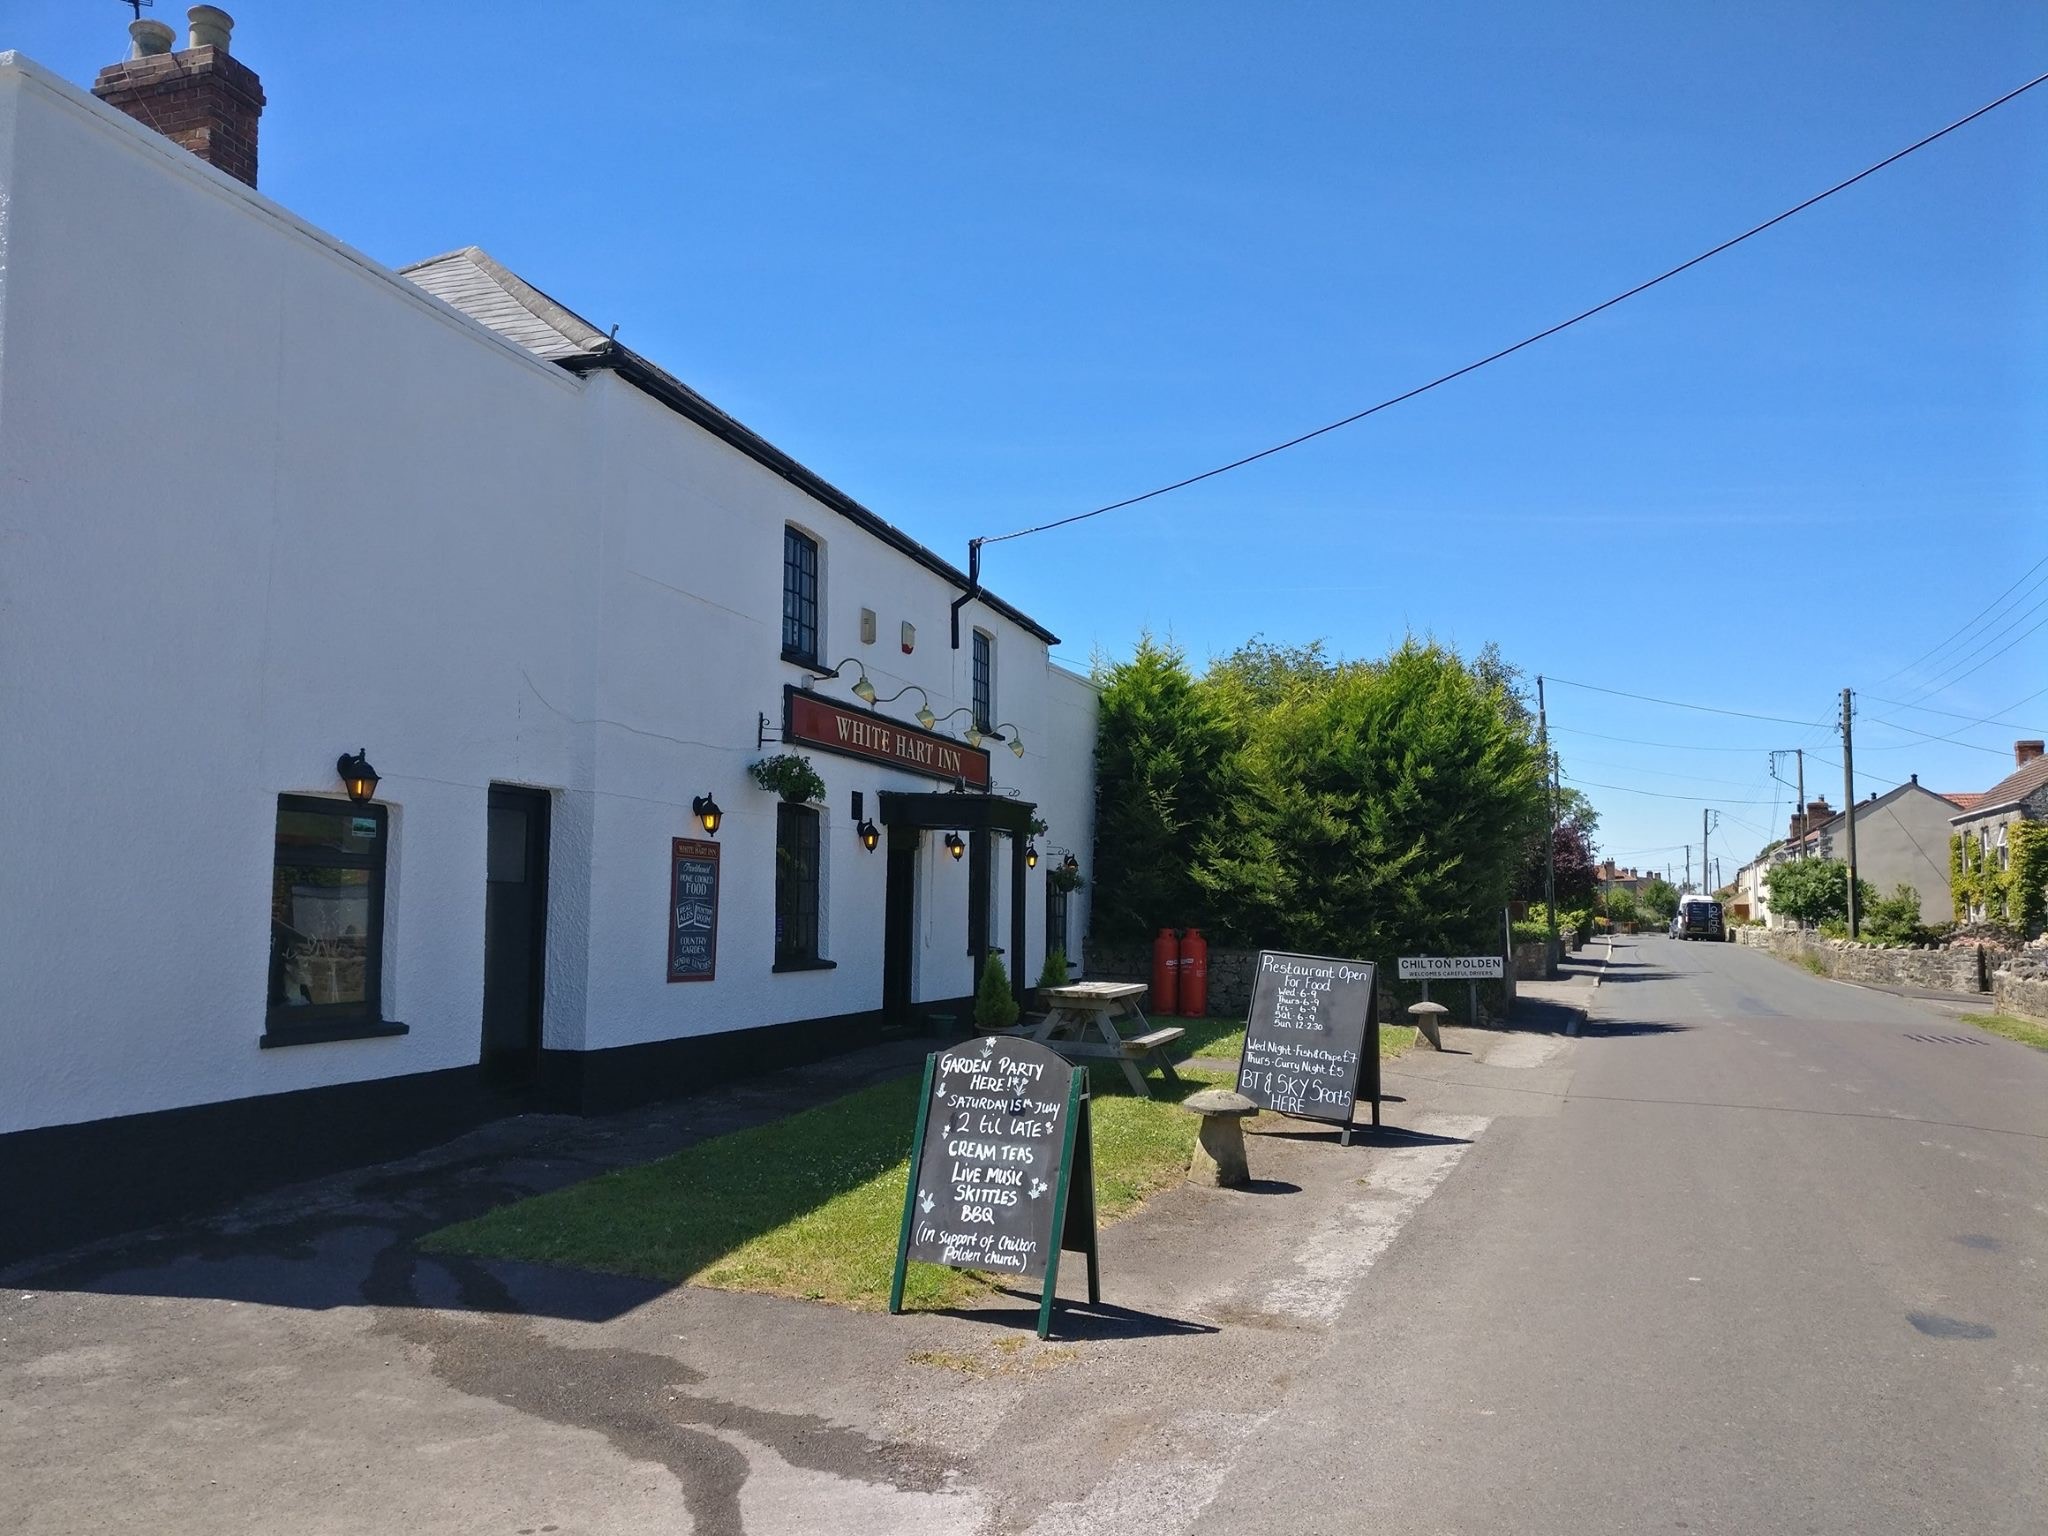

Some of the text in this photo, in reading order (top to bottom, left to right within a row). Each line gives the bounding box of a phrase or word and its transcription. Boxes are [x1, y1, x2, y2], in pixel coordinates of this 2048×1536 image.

[836, 715, 961, 773] WHITE HART INN
[686, 882, 707, 895] FOOD
[1262, 955, 1367, 984] Restaurant Open
[1401, 959, 1500, 969] CHILTON POLDEN
[1305, 976, 1331, 992] Food
[1247, 1037, 1266, 1051] Wed
[1268, 1041, 1291, 1056] Night
[941, 1054, 1044, 1080] GARDEN PARTY
[1301, 1061, 1327, 1075] Night
[1241, 1069, 1263, 1090] BT
[1264, 1072, 1273, 1095] &
[1277, 1074, 1309, 1098] SKY
[947, 1094, 1008, 1114] SATURDAY
[1271, 1093, 1306, 1113] HERE
[957, 1112, 969, 1132] 2
[979, 1113, 1002, 1135] til
[949, 1140, 1034, 1164] CREAM TEAS
[954, 1184, 1017, 1206] SKITTLES
[961, 1204, 995, 1225] BBQ
[938, 1230, 977, 1248] support
[980, 1235, 994, 1252] of
[998, 1235, 1037, 1253] Chilton
[943, 1246, 981, 1263] Polden
